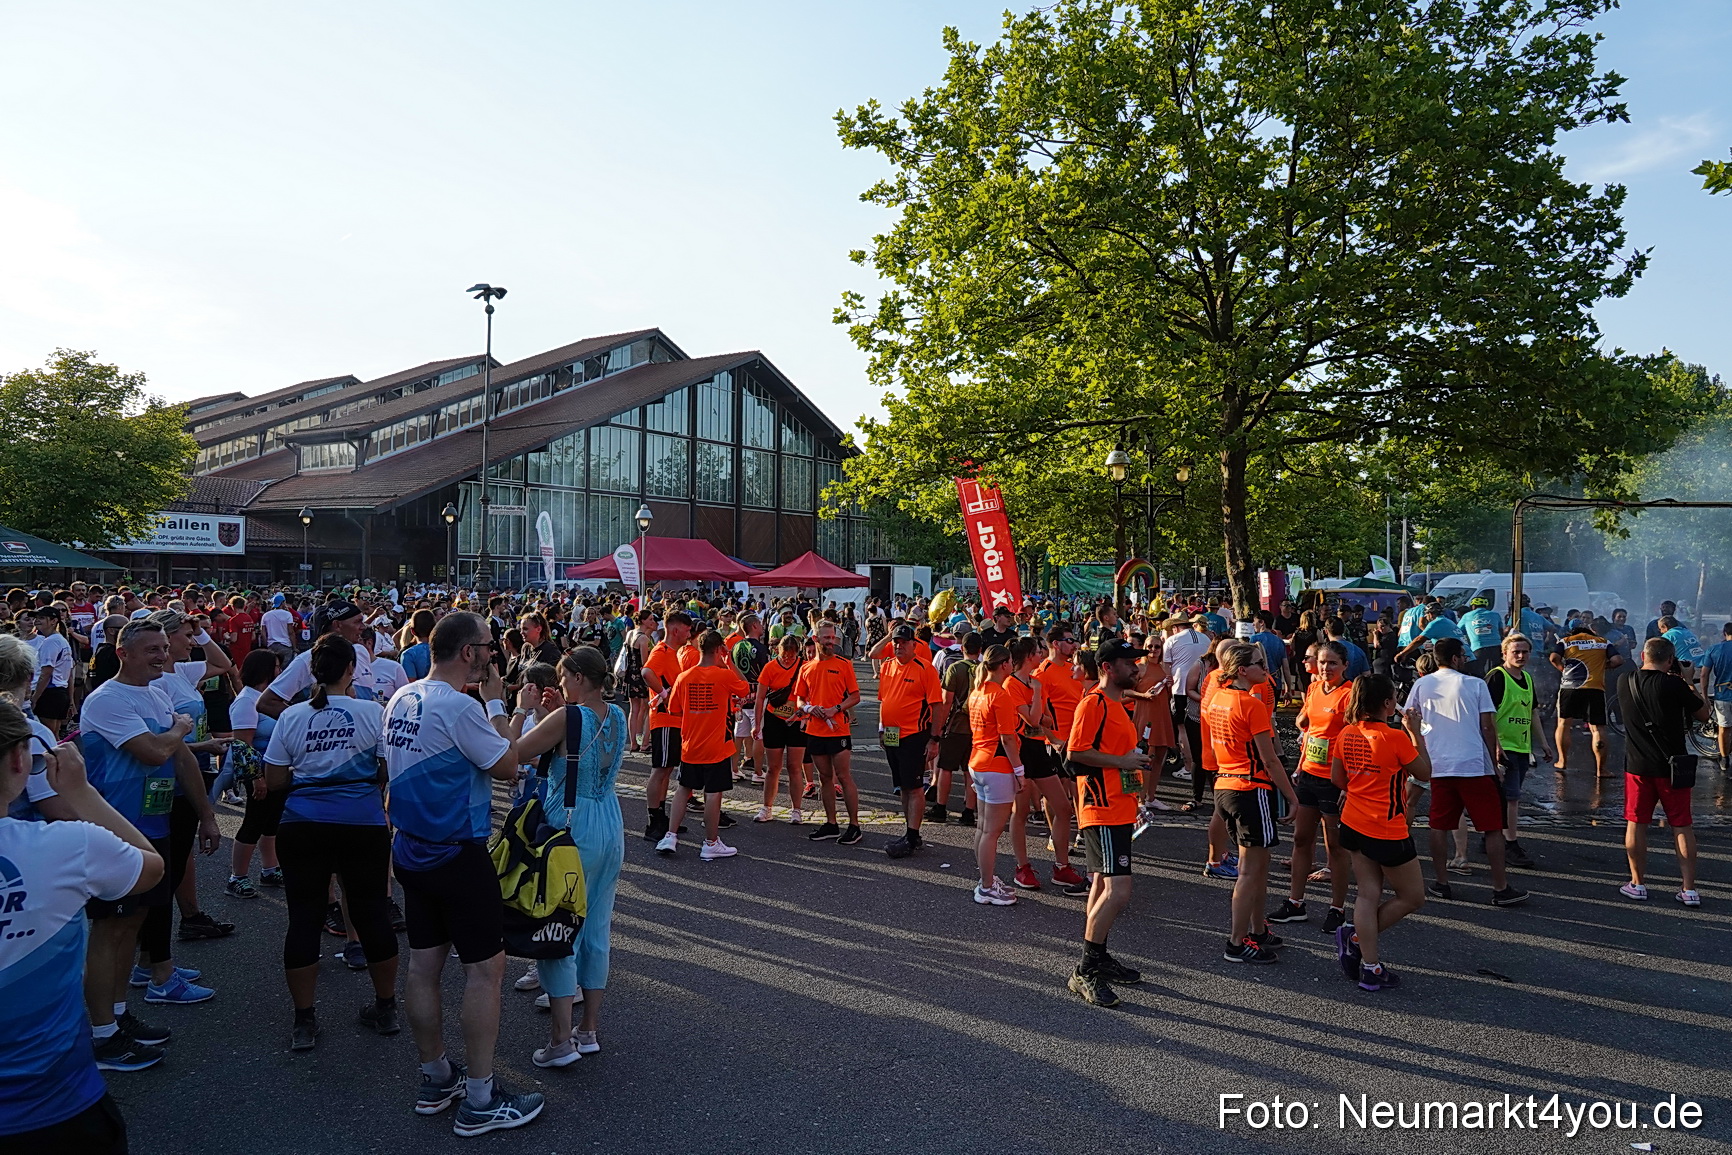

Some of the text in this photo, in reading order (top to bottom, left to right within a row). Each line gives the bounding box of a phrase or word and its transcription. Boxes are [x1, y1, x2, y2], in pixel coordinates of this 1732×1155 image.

[154, 519, 210, 530] Hallen
[388, 717, 420, 736] MOTOR
[306, 728, 355, 741] MOTOR
[1522, 730, 1527, 743] 1
[306, 740, 356, 753] LÄUFT...
